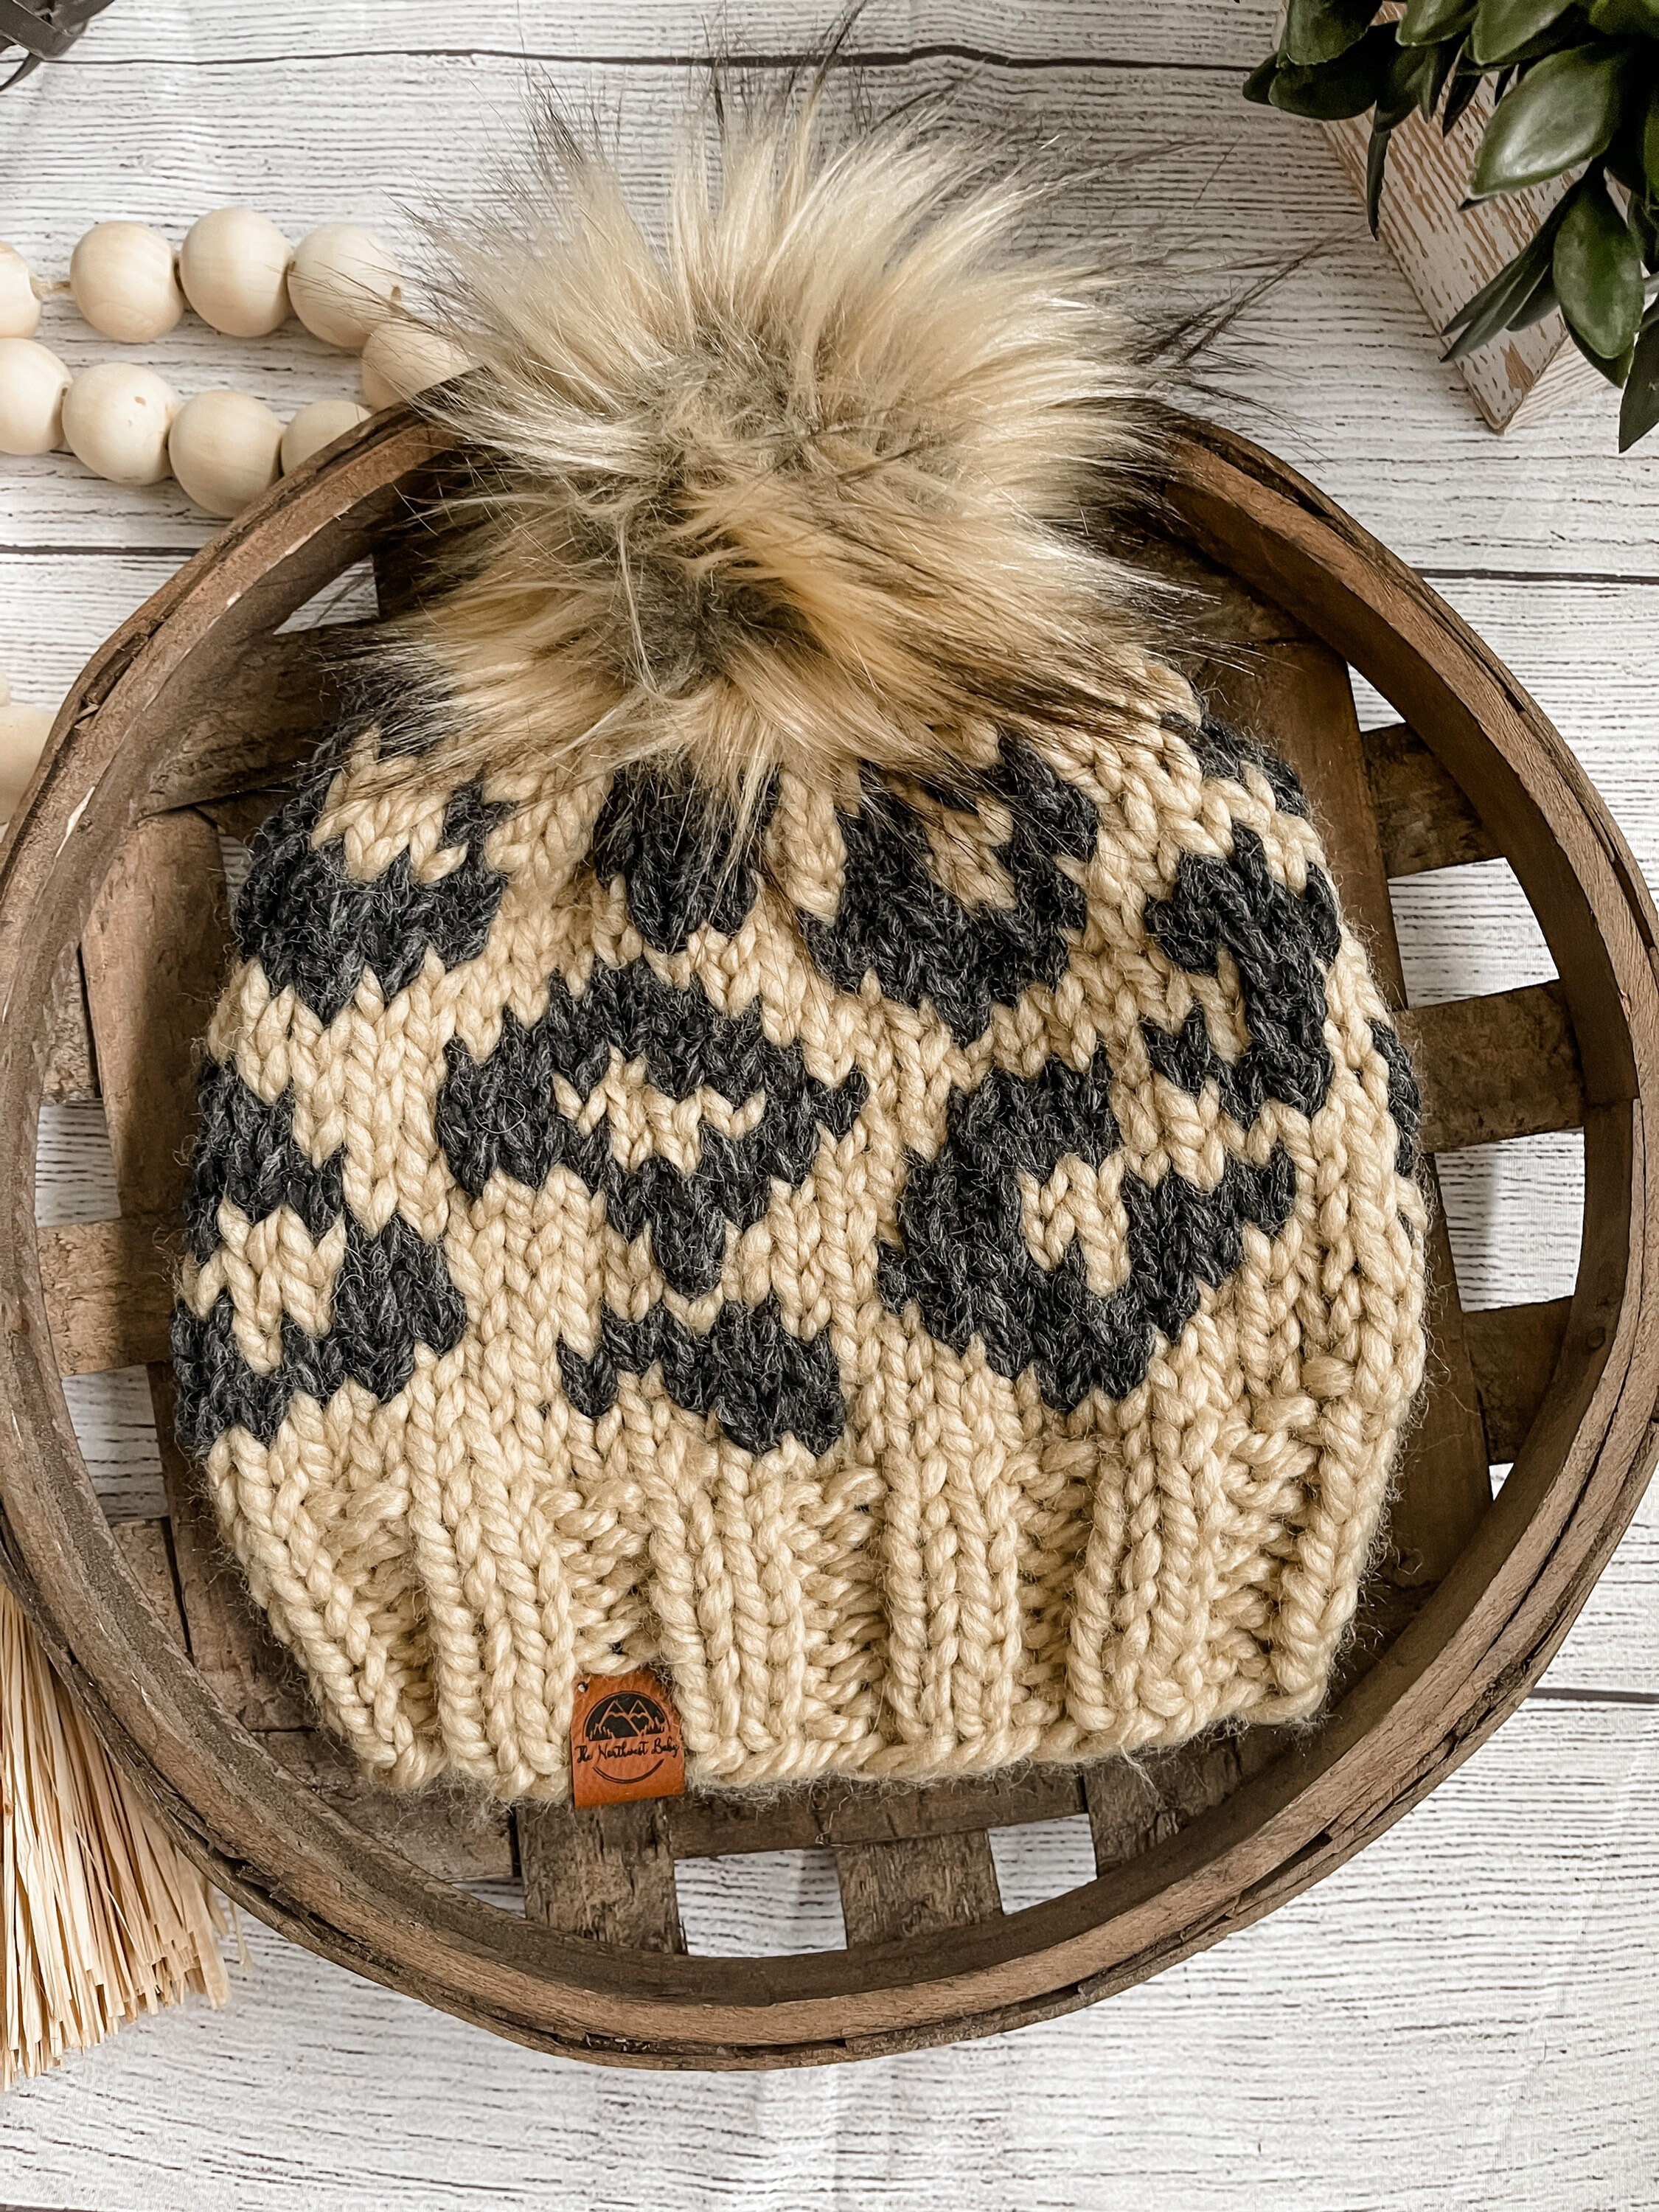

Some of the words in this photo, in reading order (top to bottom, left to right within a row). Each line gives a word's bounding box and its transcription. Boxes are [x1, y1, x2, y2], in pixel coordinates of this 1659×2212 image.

[574, 1745, 593, 1763] The
[598, 1742, 648, 1761] Northwest
[651, 1736, 679, 1758] Baby
